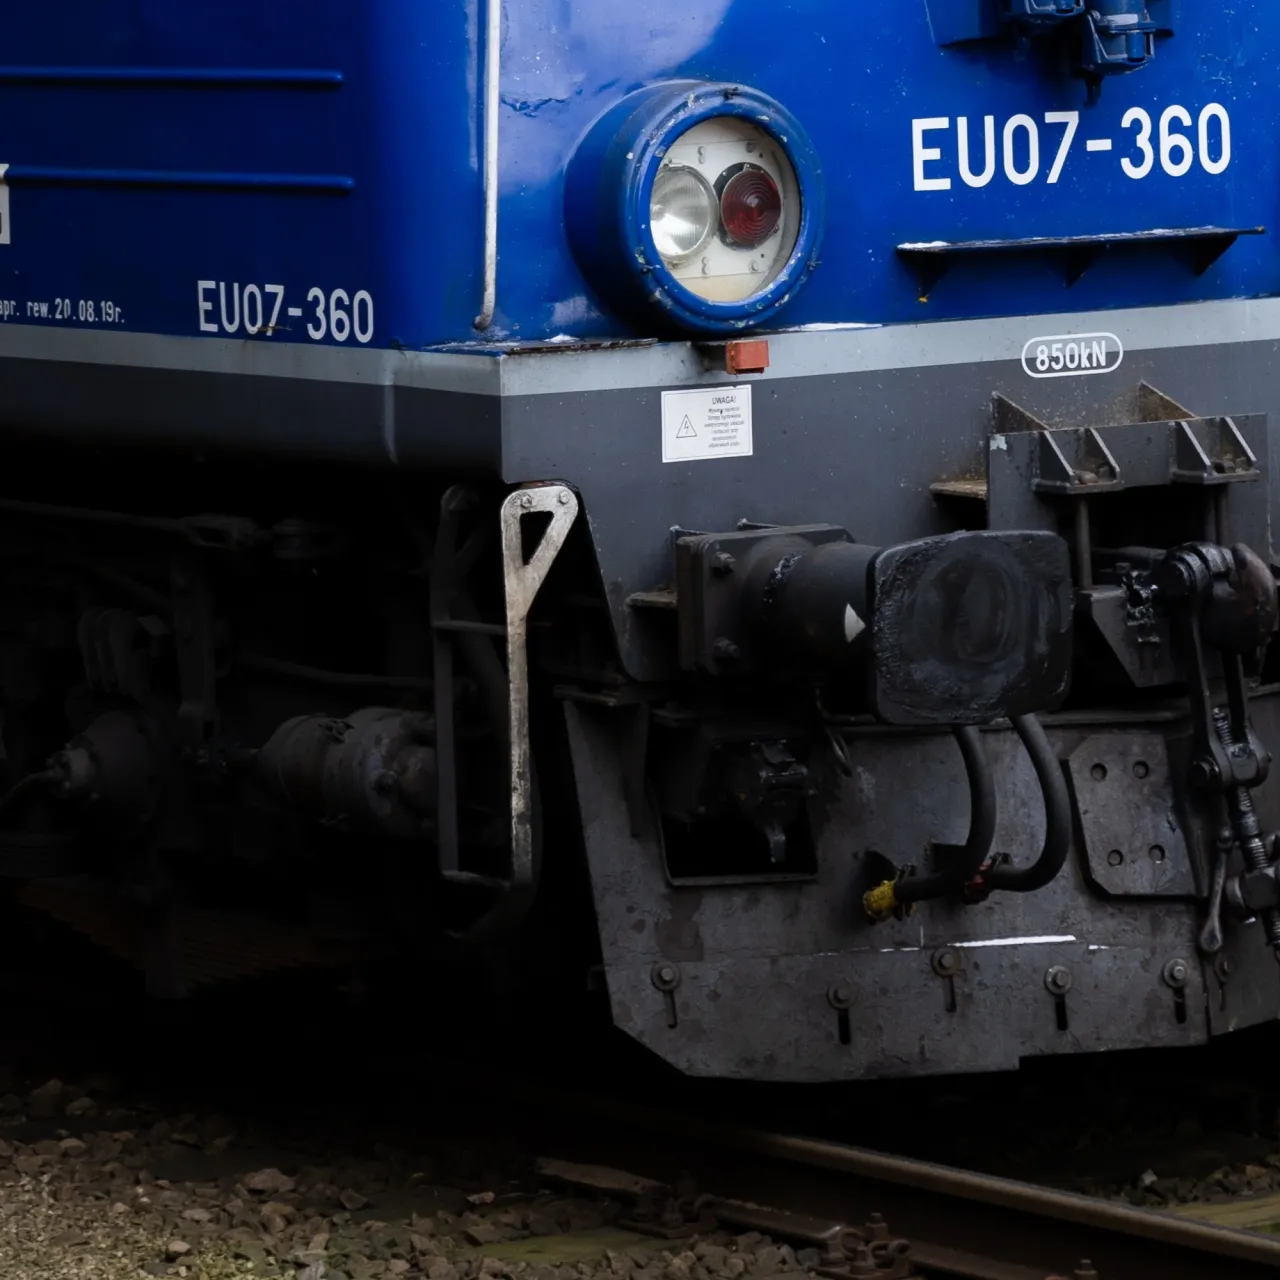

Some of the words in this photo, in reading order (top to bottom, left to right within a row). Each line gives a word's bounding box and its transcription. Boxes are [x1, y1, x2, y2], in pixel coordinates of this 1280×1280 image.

[912, 102, 1231, 191] EU07-360
[197, 280, 375, 343] EU07-360
[1036, 340, 1107, 371] 850kN
[712, 396, 737, 405] UWAGA!
